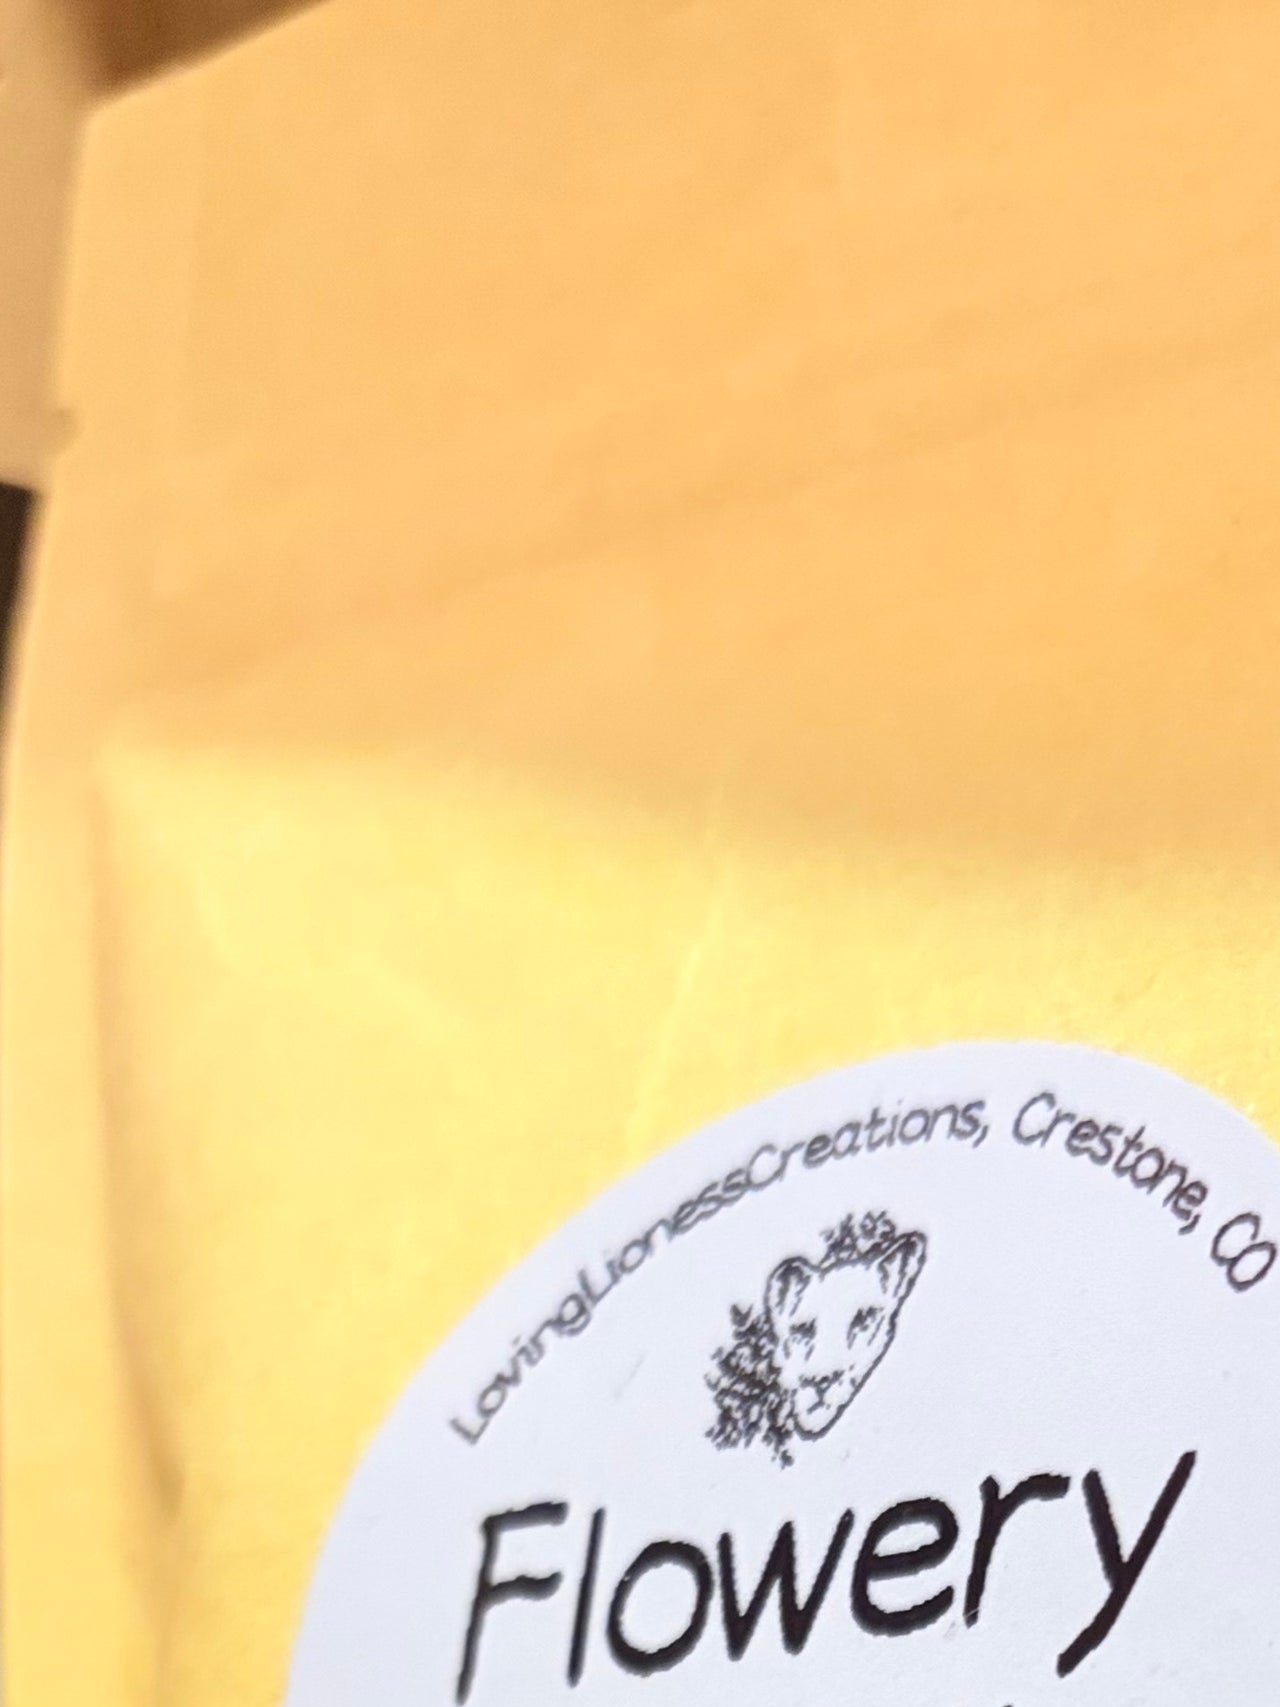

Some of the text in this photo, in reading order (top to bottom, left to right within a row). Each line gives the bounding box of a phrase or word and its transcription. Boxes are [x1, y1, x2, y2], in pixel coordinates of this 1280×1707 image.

[449, 1090, 1279, 1446] LovingLionessCreations, Crestone, CO
[453, 1448, 1199, 1707] Flowery
